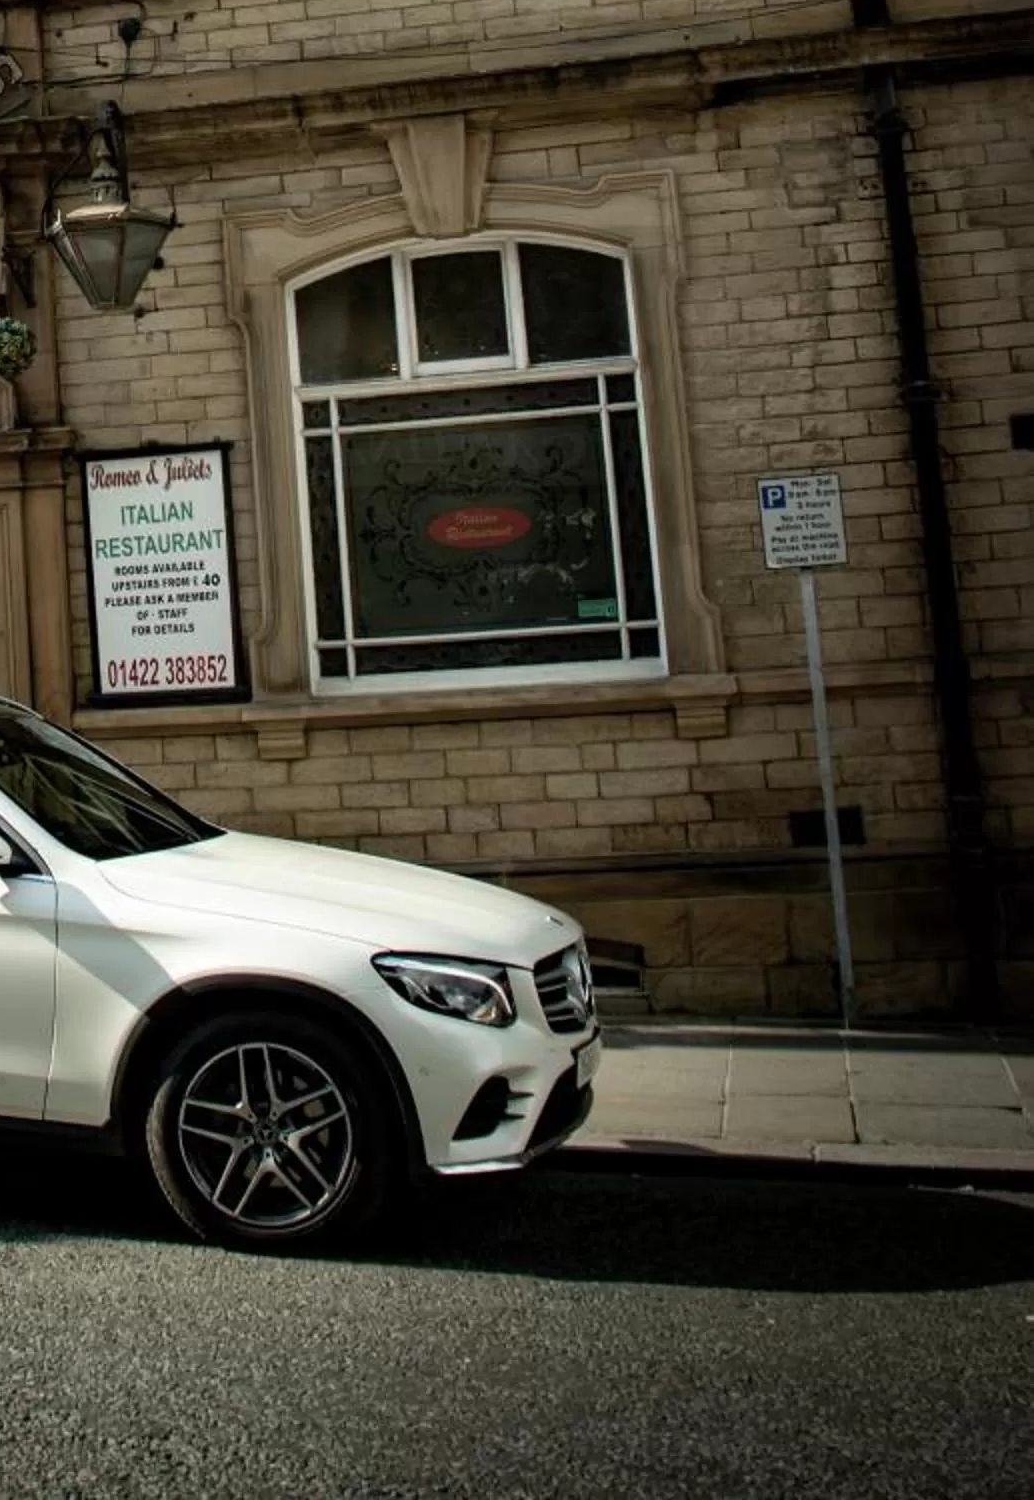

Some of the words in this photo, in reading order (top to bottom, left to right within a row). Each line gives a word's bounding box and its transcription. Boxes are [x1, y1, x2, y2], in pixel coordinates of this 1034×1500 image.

[145, 460, 159, 485] &
[767, 488, 782, 507] P
[120, 501, 194, 525] ITALIAN
[95, 529, 224, 560] RESTAURANT
[115, 563, 149, 576] ROOMS
[153, 561, 205, 574] AVAILABLE
[111, 579, 159, 592] UPSTAIRS
[162, 577, 191, 589] FROM
[202, 573, 221, 587] 40
[105, 595, 140, 608] PLEASE
[143, 594, 164, 605] ASK
[167, 593, 175, 604] A
[176, 591, 219, 603] MEMBER
[137, 610, 149, 621] OF
[157, 608, 189, 620] STAFF
[131, 625, 151, 636] FOR
[154, 623, 195, 636] DETAILS
[107, 659, 160, 688] 01422
[165, 654, 228, 684] 383852
